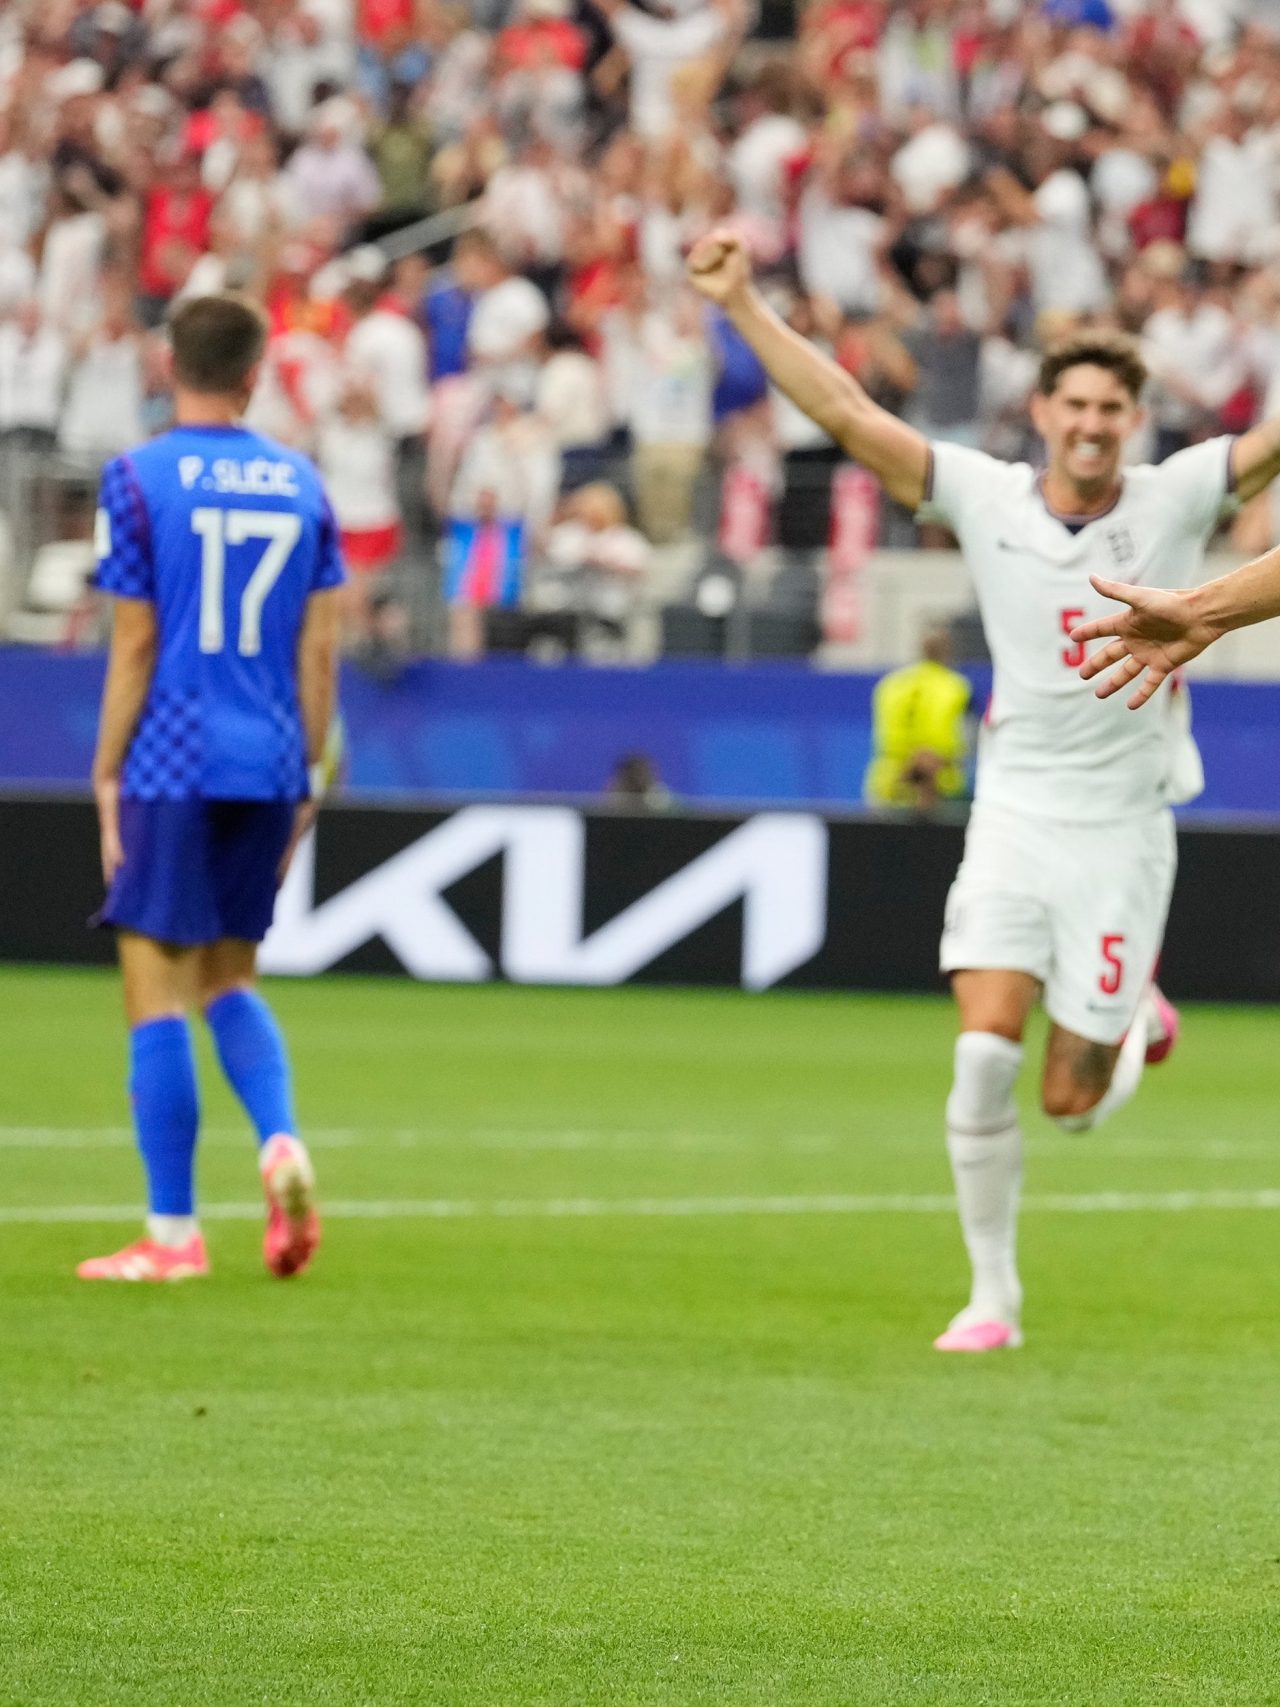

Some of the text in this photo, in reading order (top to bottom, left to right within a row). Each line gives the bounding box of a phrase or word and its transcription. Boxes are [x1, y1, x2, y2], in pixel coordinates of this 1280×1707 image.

[191, 506, 302, 657] 17
[1059, 608, 1087, 668] 5
[1099, 934, 1126, 995] 5
